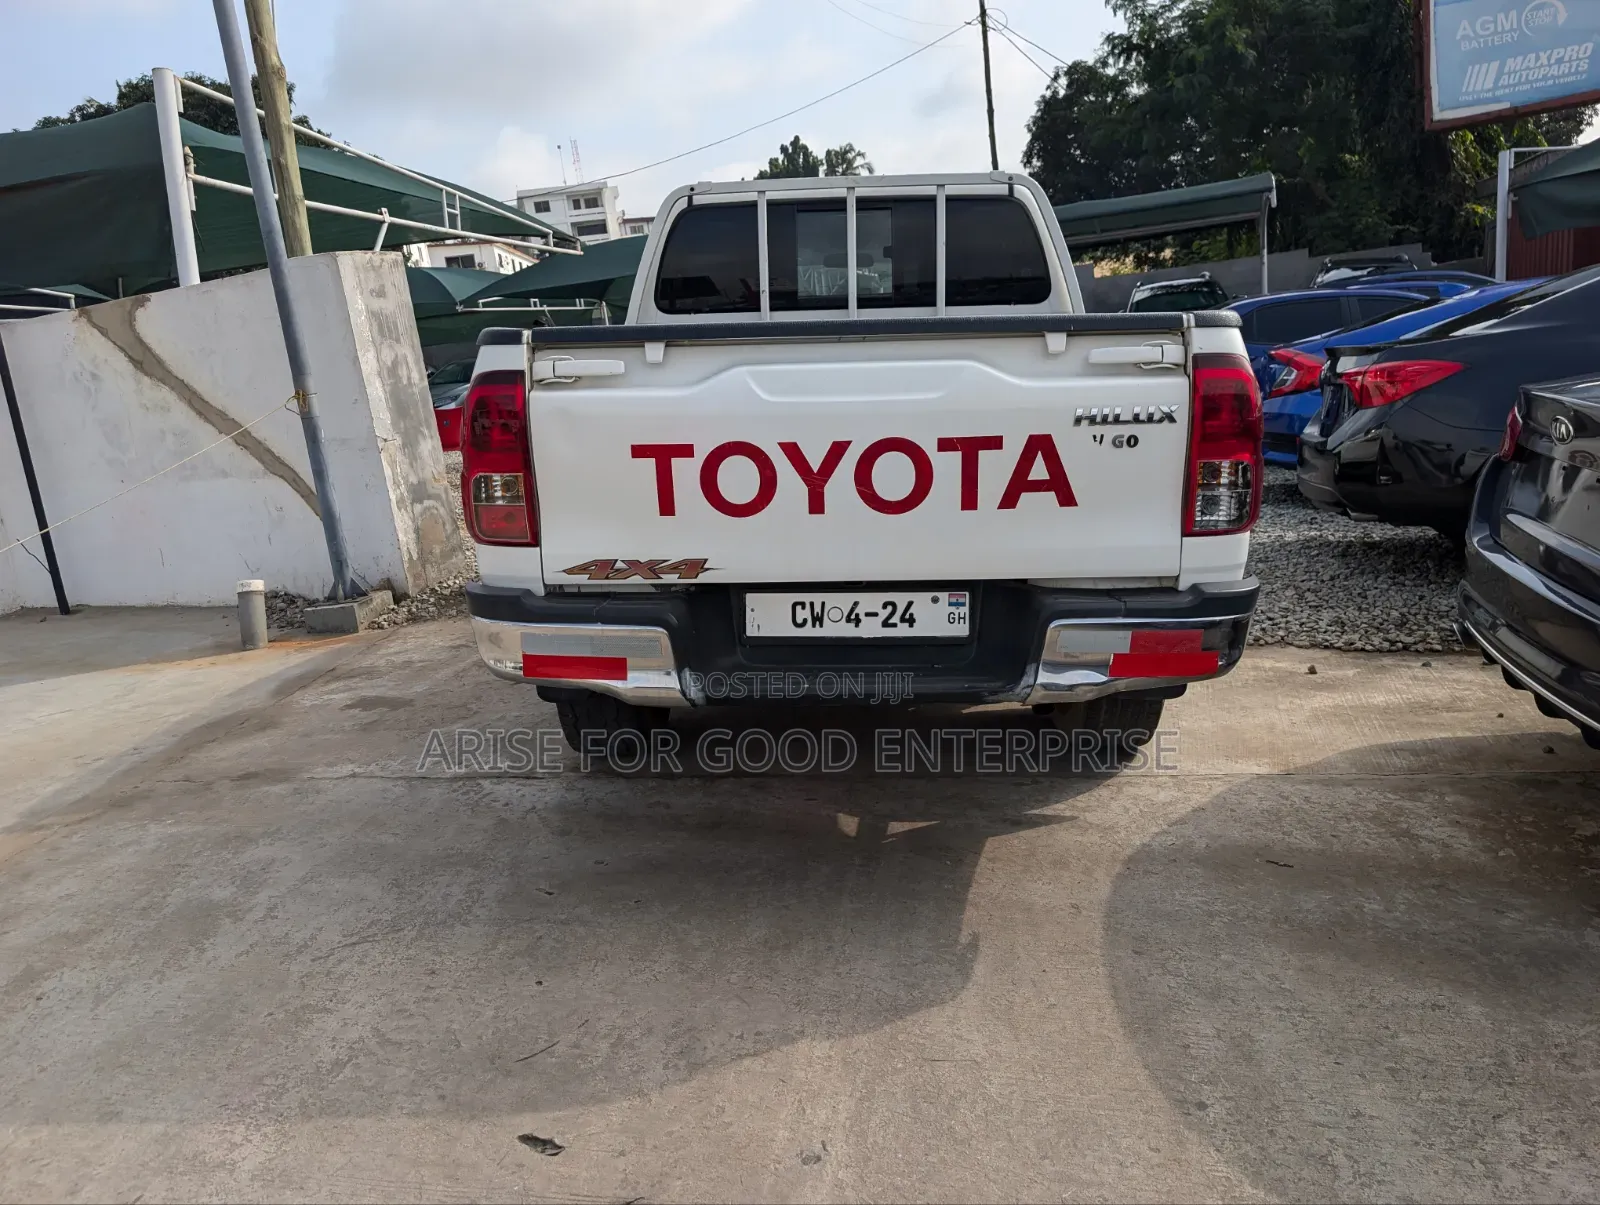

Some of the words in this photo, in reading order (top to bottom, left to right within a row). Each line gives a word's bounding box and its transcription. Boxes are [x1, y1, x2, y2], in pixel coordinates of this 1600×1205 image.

[1456, 9, 1517, 40] AGM
[1461, 30, 1520, 51] BATTERY
[1503, 42, 1594, 73] MAXPRO
[1498, 59, 1590, 86] AUTOPARTS
[1073, 404, 1180, 426] HILUX
[631, 434, 1078, 518] TOYOTA
[948, 612, 966, 625] GH
